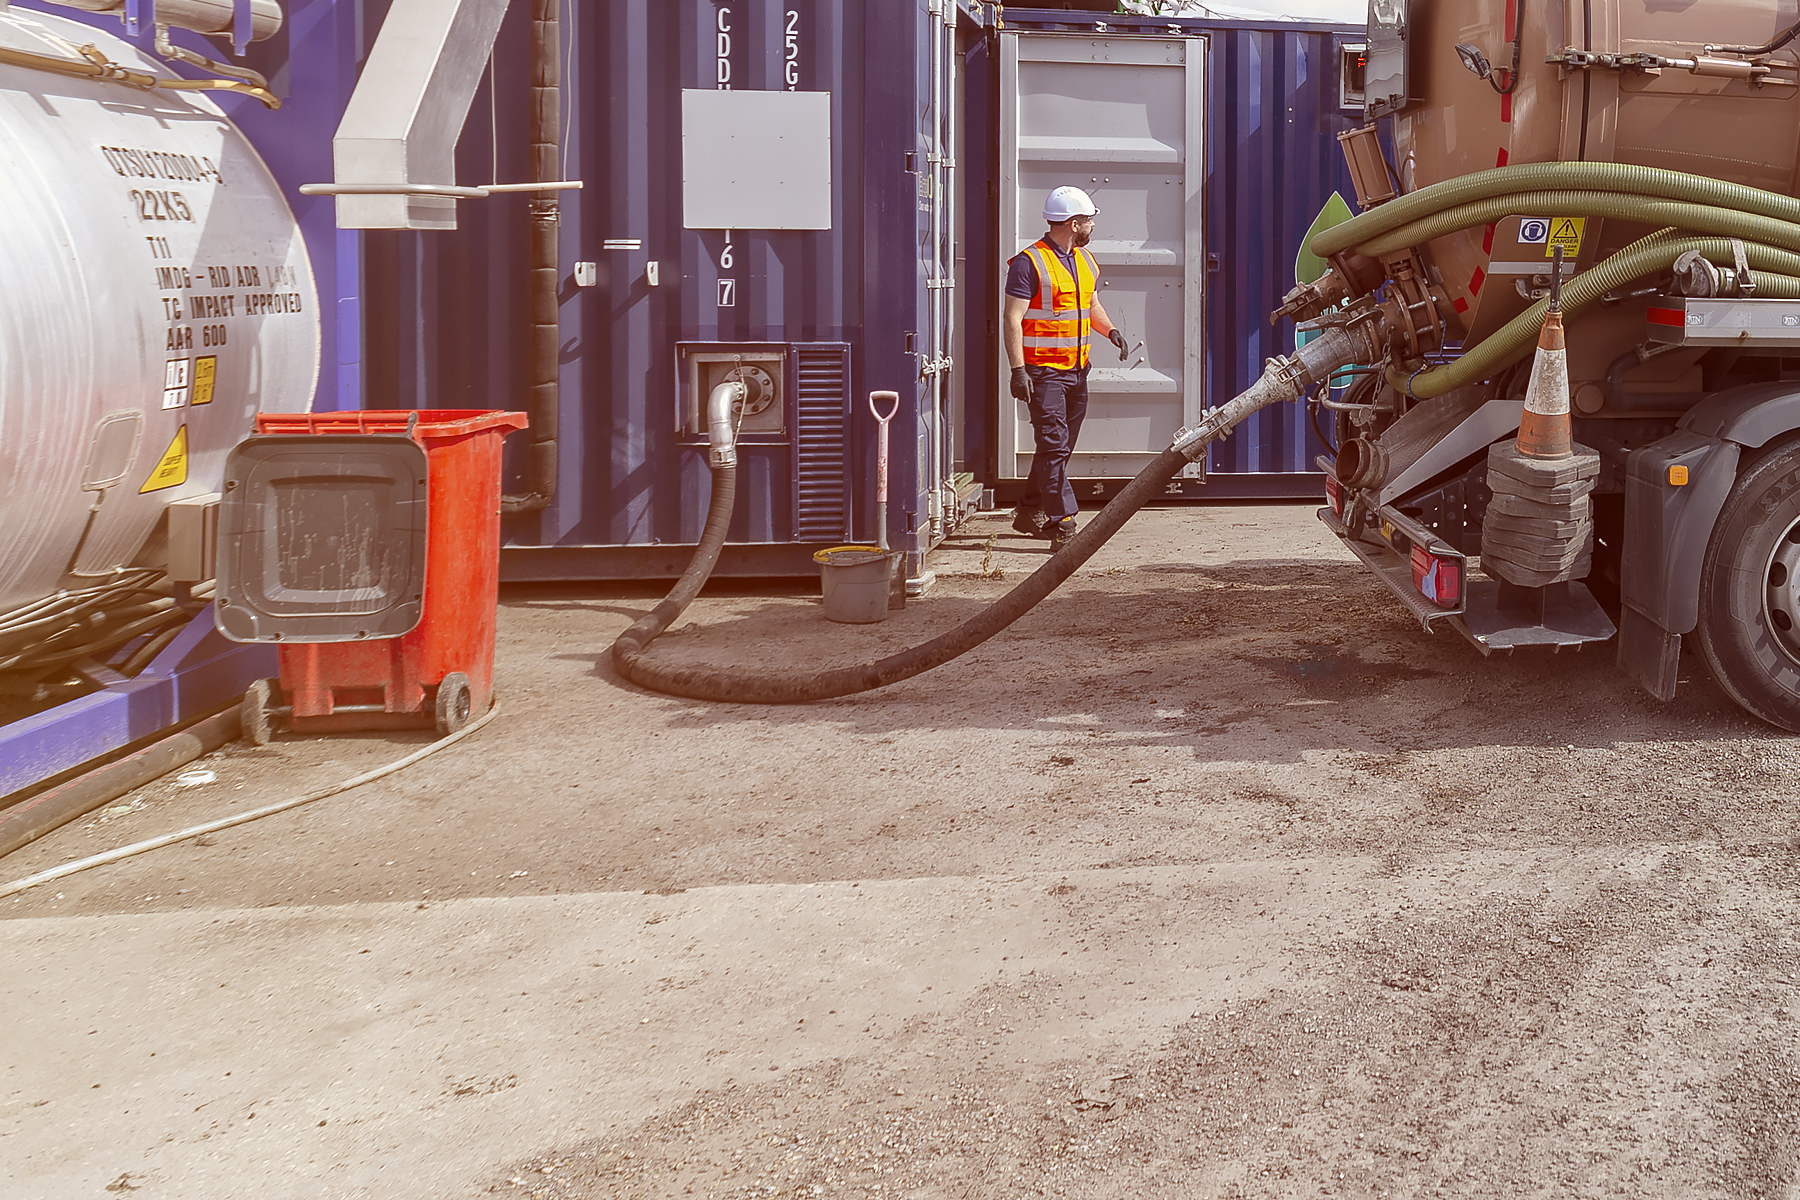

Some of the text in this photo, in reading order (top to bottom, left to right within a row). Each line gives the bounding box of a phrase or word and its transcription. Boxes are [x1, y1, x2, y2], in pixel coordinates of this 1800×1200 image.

[717, 7, 732, 90] CDD
[785, 10, 800, 92] 25G
[155, 266, 192, 290] IMDG
[189, 294, 235, 319] IMPACT
[245, 292, 302, 316] APPROVED
[166, 324, 227, 351] AAR 600
